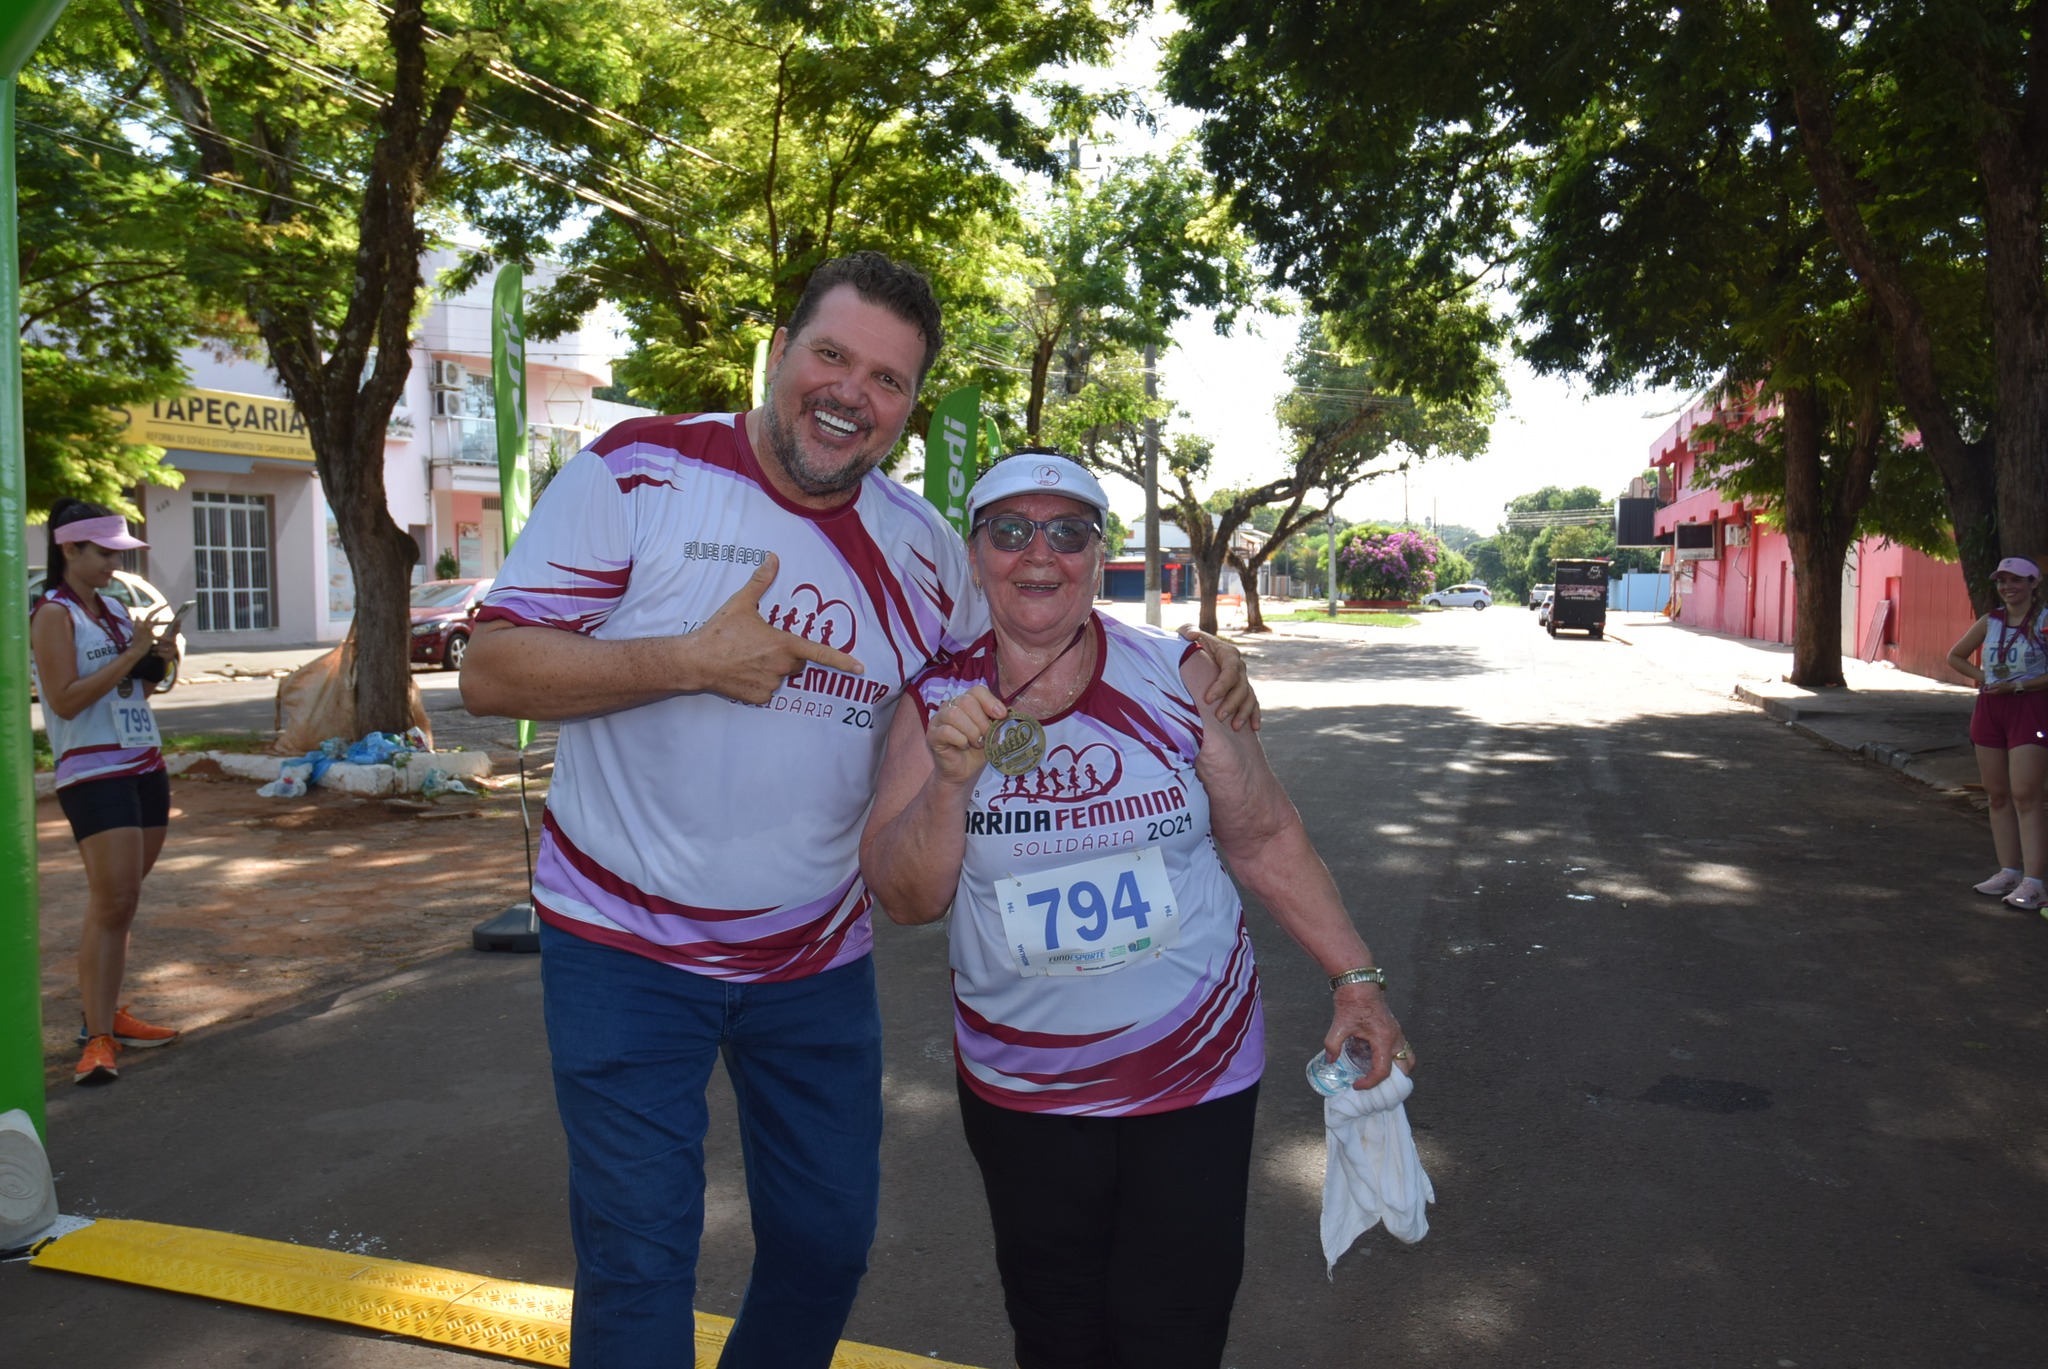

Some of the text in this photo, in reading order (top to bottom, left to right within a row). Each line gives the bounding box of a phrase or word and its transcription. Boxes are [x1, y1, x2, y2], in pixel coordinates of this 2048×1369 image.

[152, 396, 306, 434] TAPEÇARIA
[684, 541, 772, 566] EQUIPE DE APOI
[1990, 647, 2018, 663] 70
[787, 666, 889, 704] EMININA
[119, 708, 152, 733] 799
[730, 696, 833, 718] IDÁRIA
[1012, 812, 1193, 857] SOLIDÁRIA 2024
[1027, 870, 1151, 950] 794
